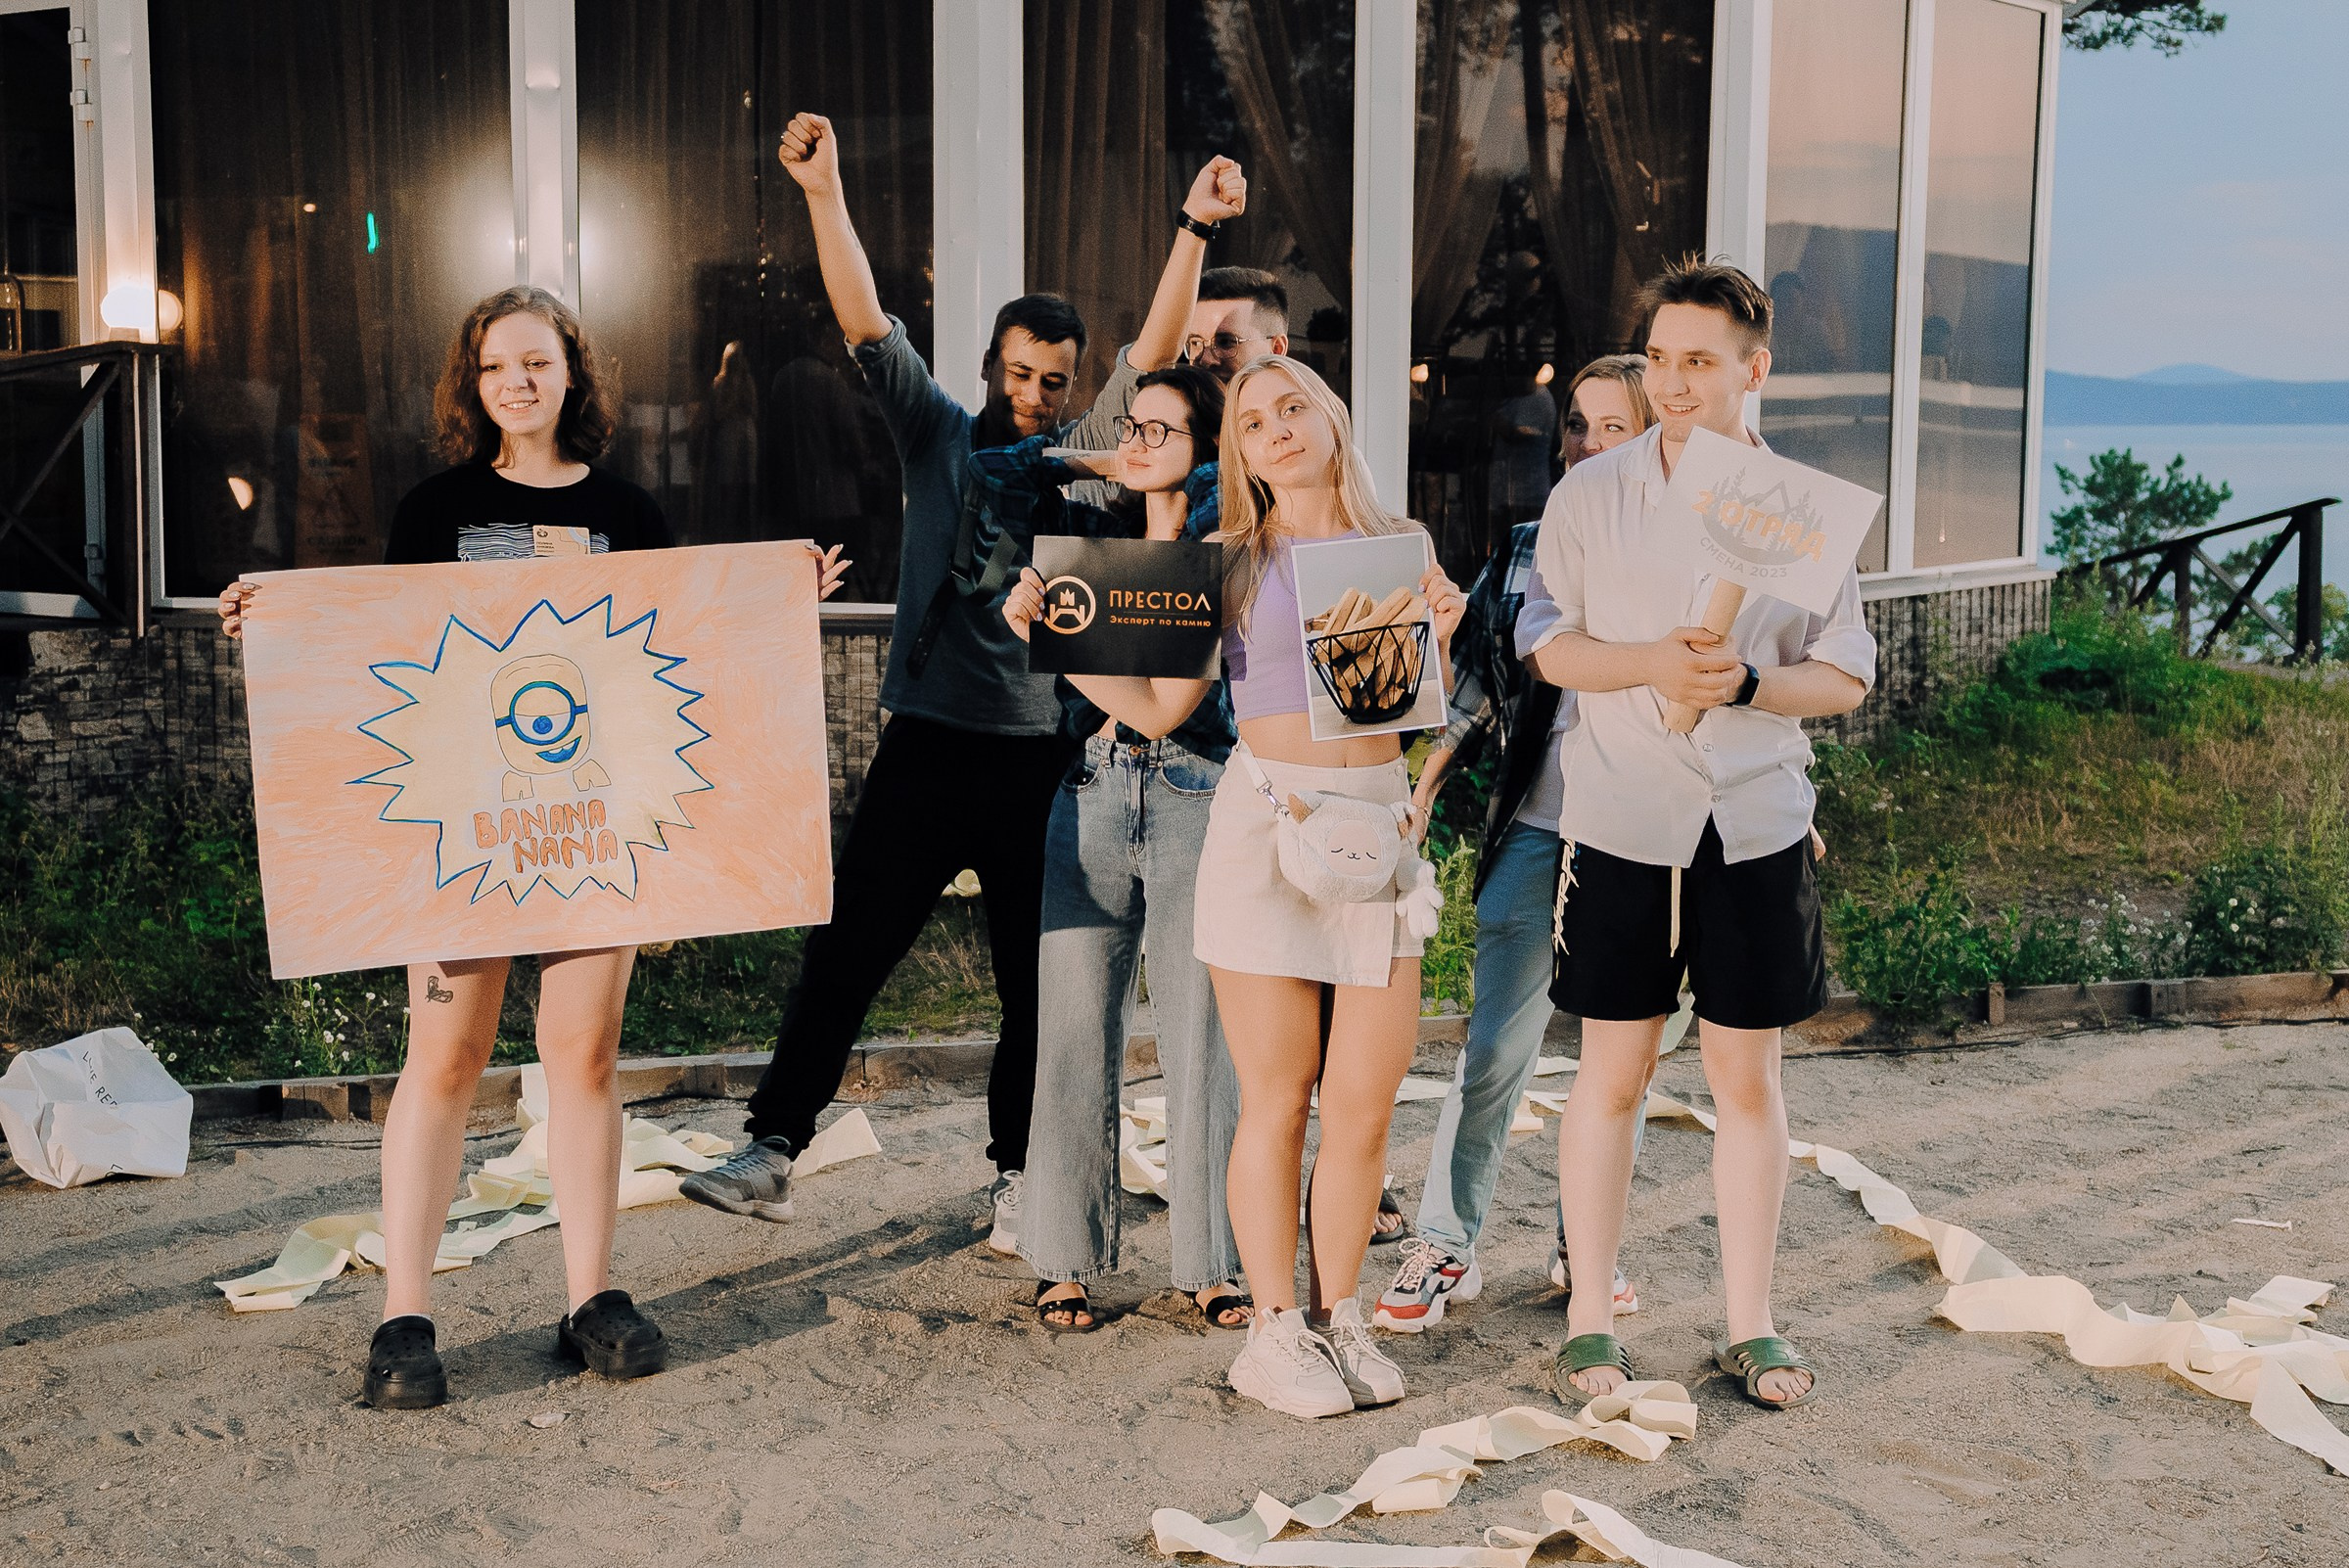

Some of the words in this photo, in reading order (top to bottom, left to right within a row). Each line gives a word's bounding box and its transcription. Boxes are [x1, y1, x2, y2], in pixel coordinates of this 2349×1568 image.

[1691, 490, 1713, 516] 2
[1719, 500, 1827, 564] ОТРЯД
[1700, 536, 1745, 574] СМЕНА
[1750, 567, 1787, 577] 2023
[1109, 589, 1211, 612] ПРЕСТОЛ
[1109, 615, 1155, 626] Эксперт
[1159, 618, 1172, 626] по
[1175, 618, 1212, 627] камню
[473, 799, 606, 849] BANANA
[513, 829, 618, 873] NANA
